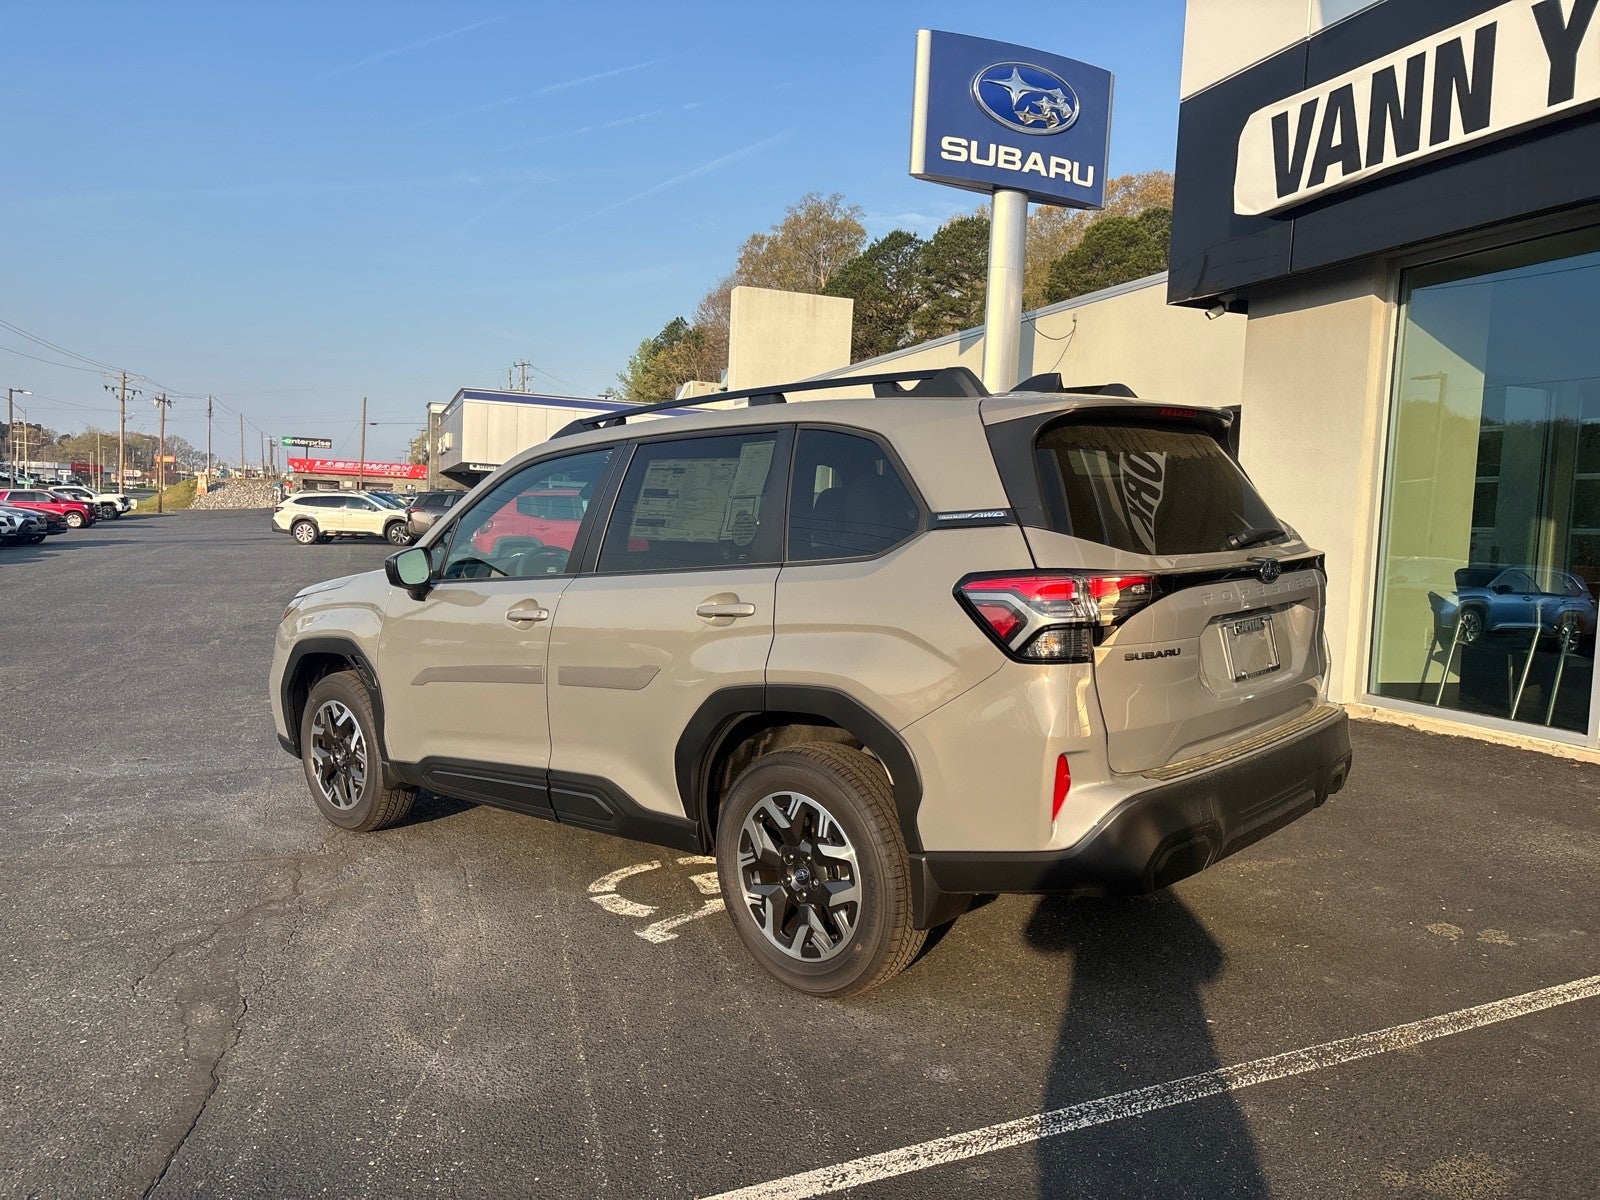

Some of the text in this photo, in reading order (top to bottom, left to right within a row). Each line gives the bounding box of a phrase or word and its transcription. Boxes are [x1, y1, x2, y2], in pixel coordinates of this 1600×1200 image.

[1271, 0, 1598, 199] VANN Y
[940, 136, 1094, 188] SUBARU
[283, 438, 331, 446] enterprise
[1124, 648, 1181, 661] SUBARU
